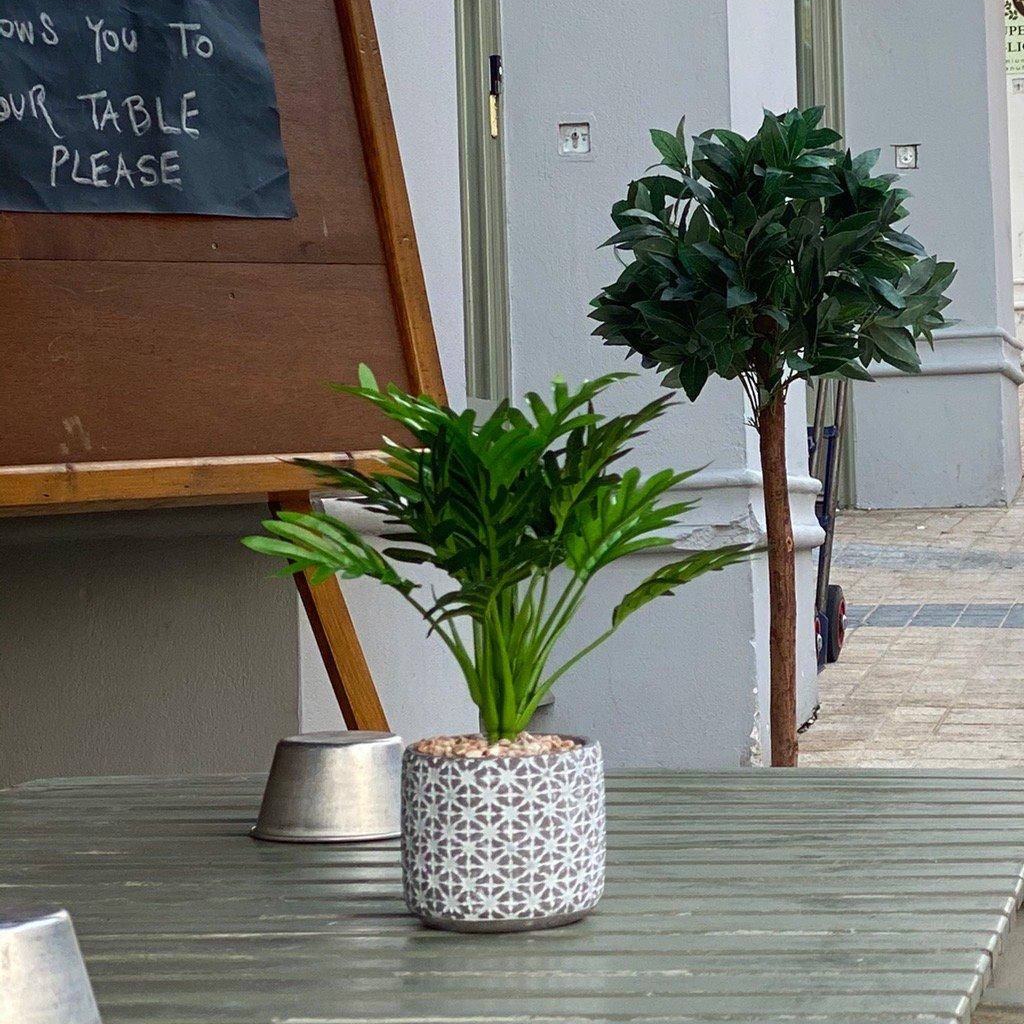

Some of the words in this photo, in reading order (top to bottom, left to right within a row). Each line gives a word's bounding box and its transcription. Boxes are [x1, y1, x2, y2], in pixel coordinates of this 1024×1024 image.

[0, 12, 59, 46] OWS
[86, 16, 138, 63] YOU
[169, 23, 214, 59] TO
[0, 84, 64, 139] OUR
[78, 91, 199, 136] TABLE
[51, 145, 183, 190] PLEASE
